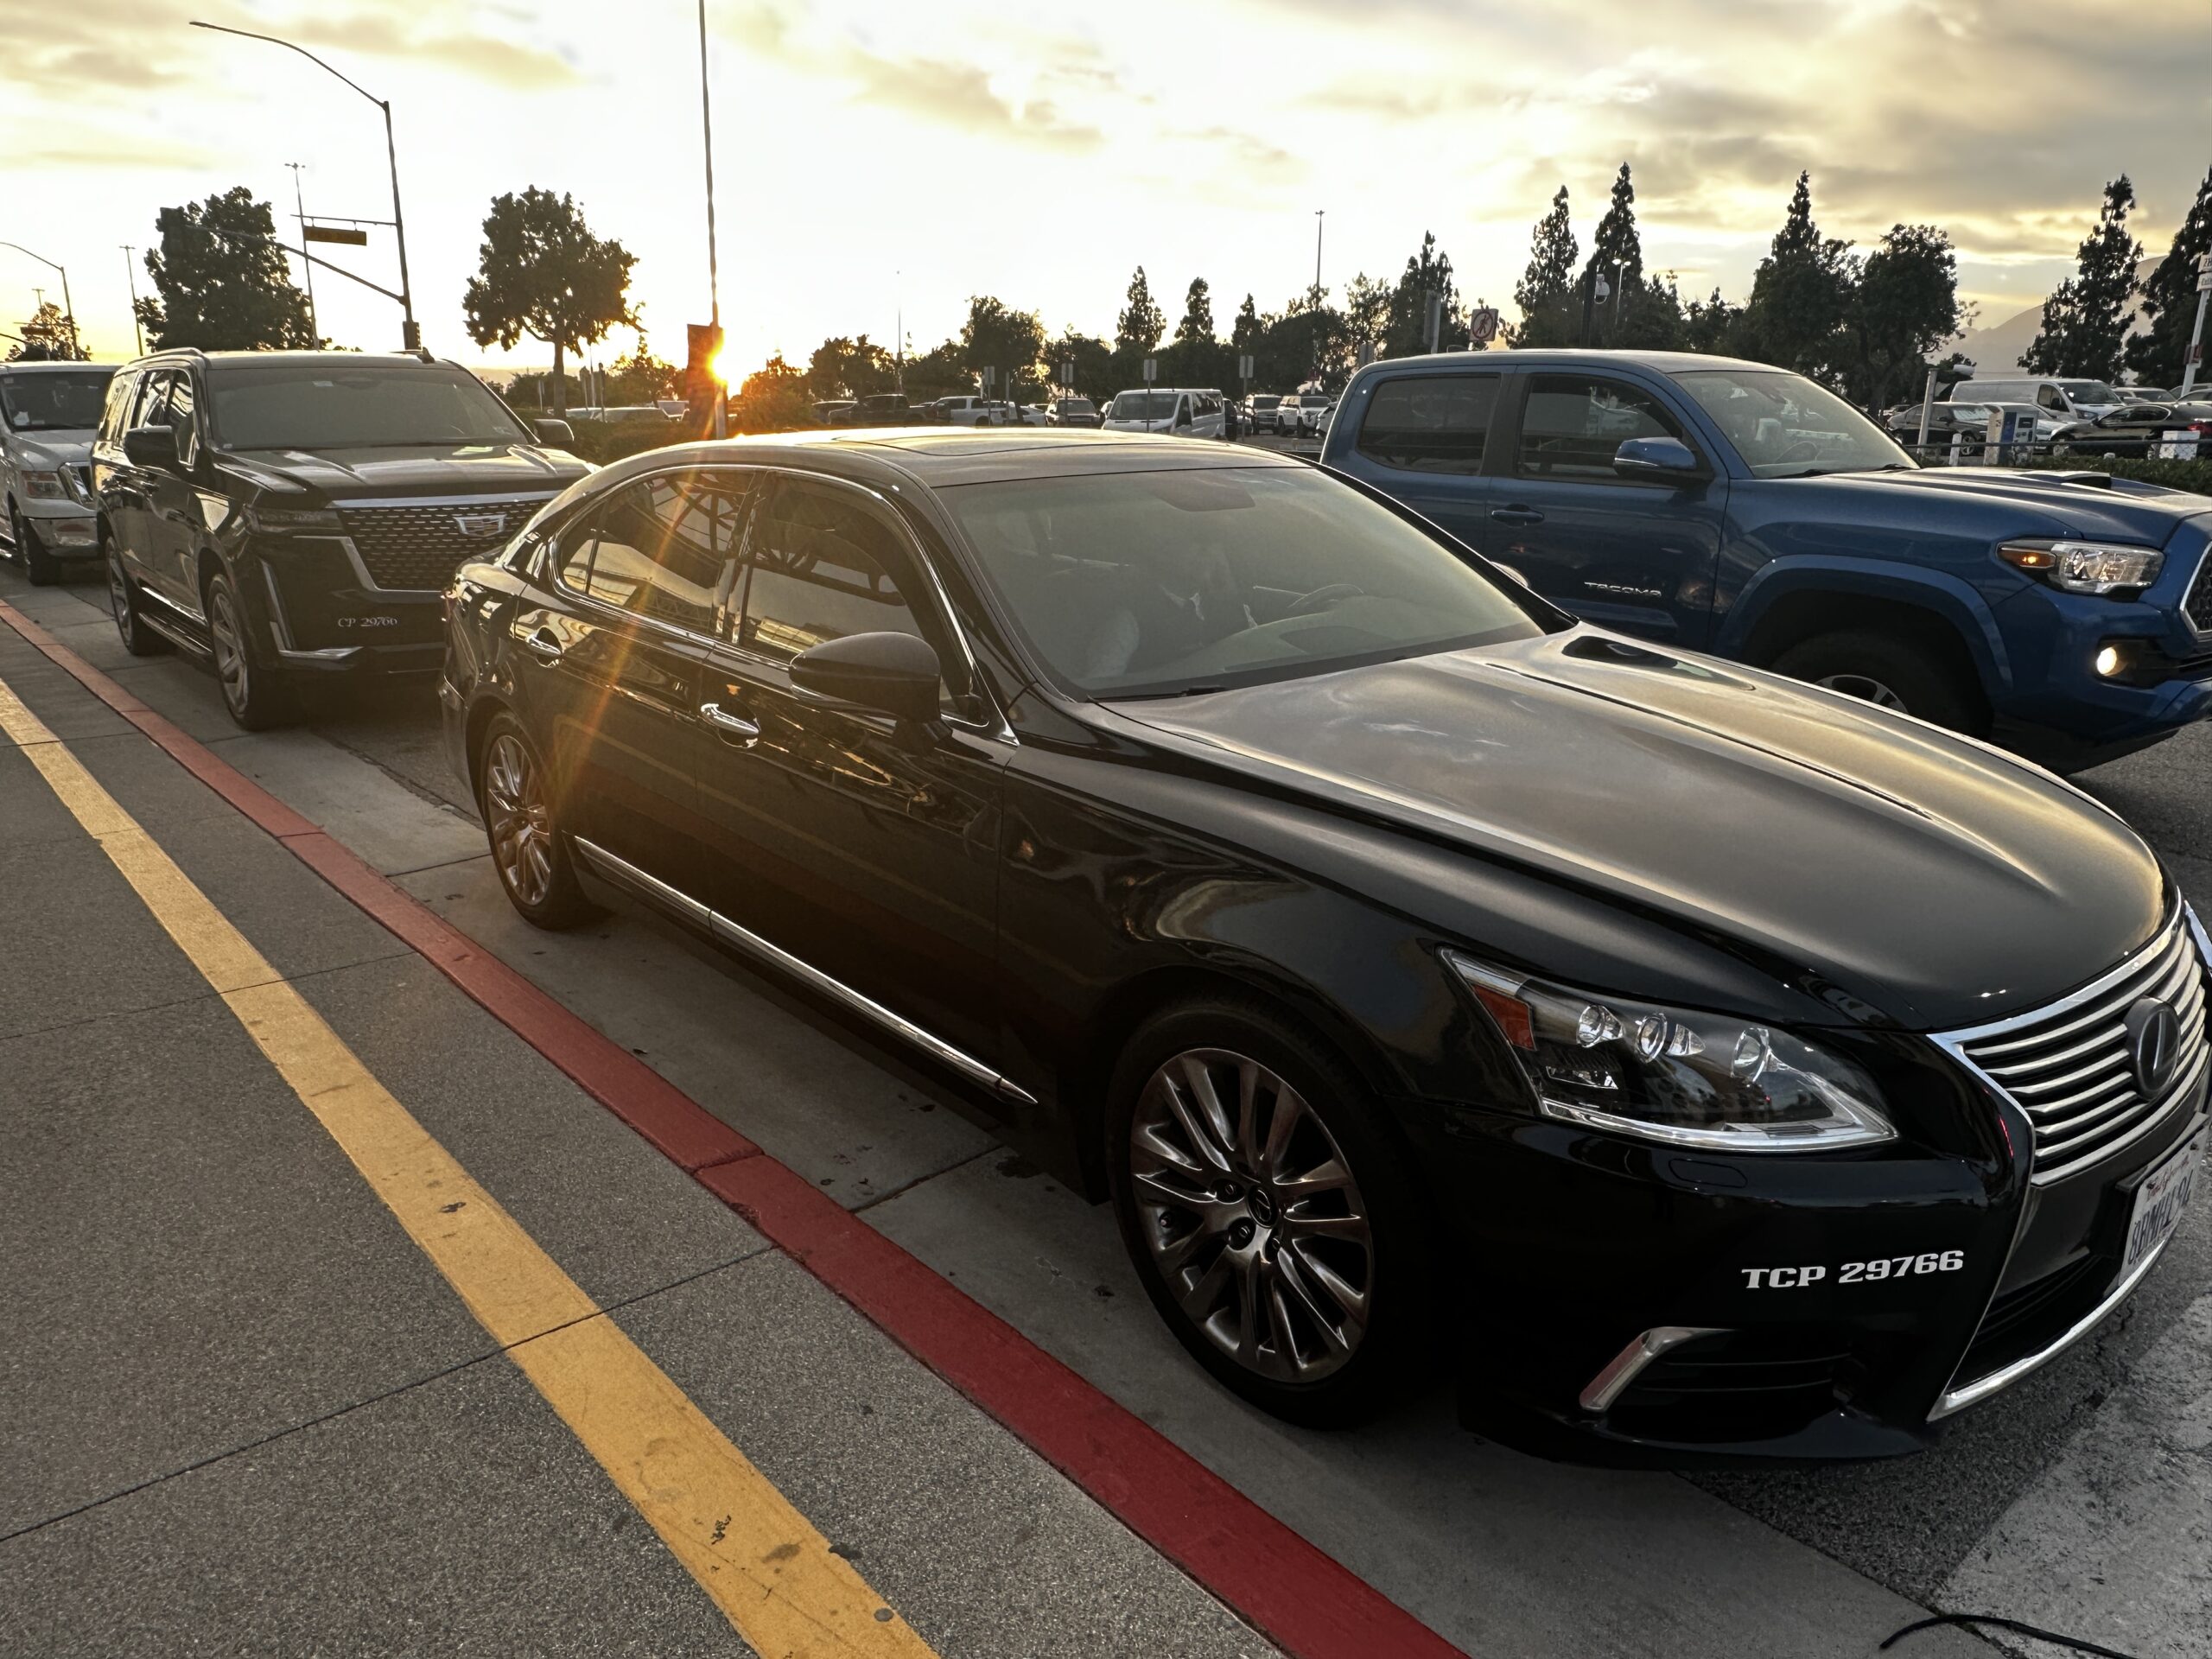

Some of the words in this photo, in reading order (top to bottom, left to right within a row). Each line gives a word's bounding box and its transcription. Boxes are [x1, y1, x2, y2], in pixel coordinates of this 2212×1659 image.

[1584, 582, 1662, 597] TACOMA
[1741, 1265, 1826, 1288] TCP
[1838, 1249, 1964, 1284] 29766
